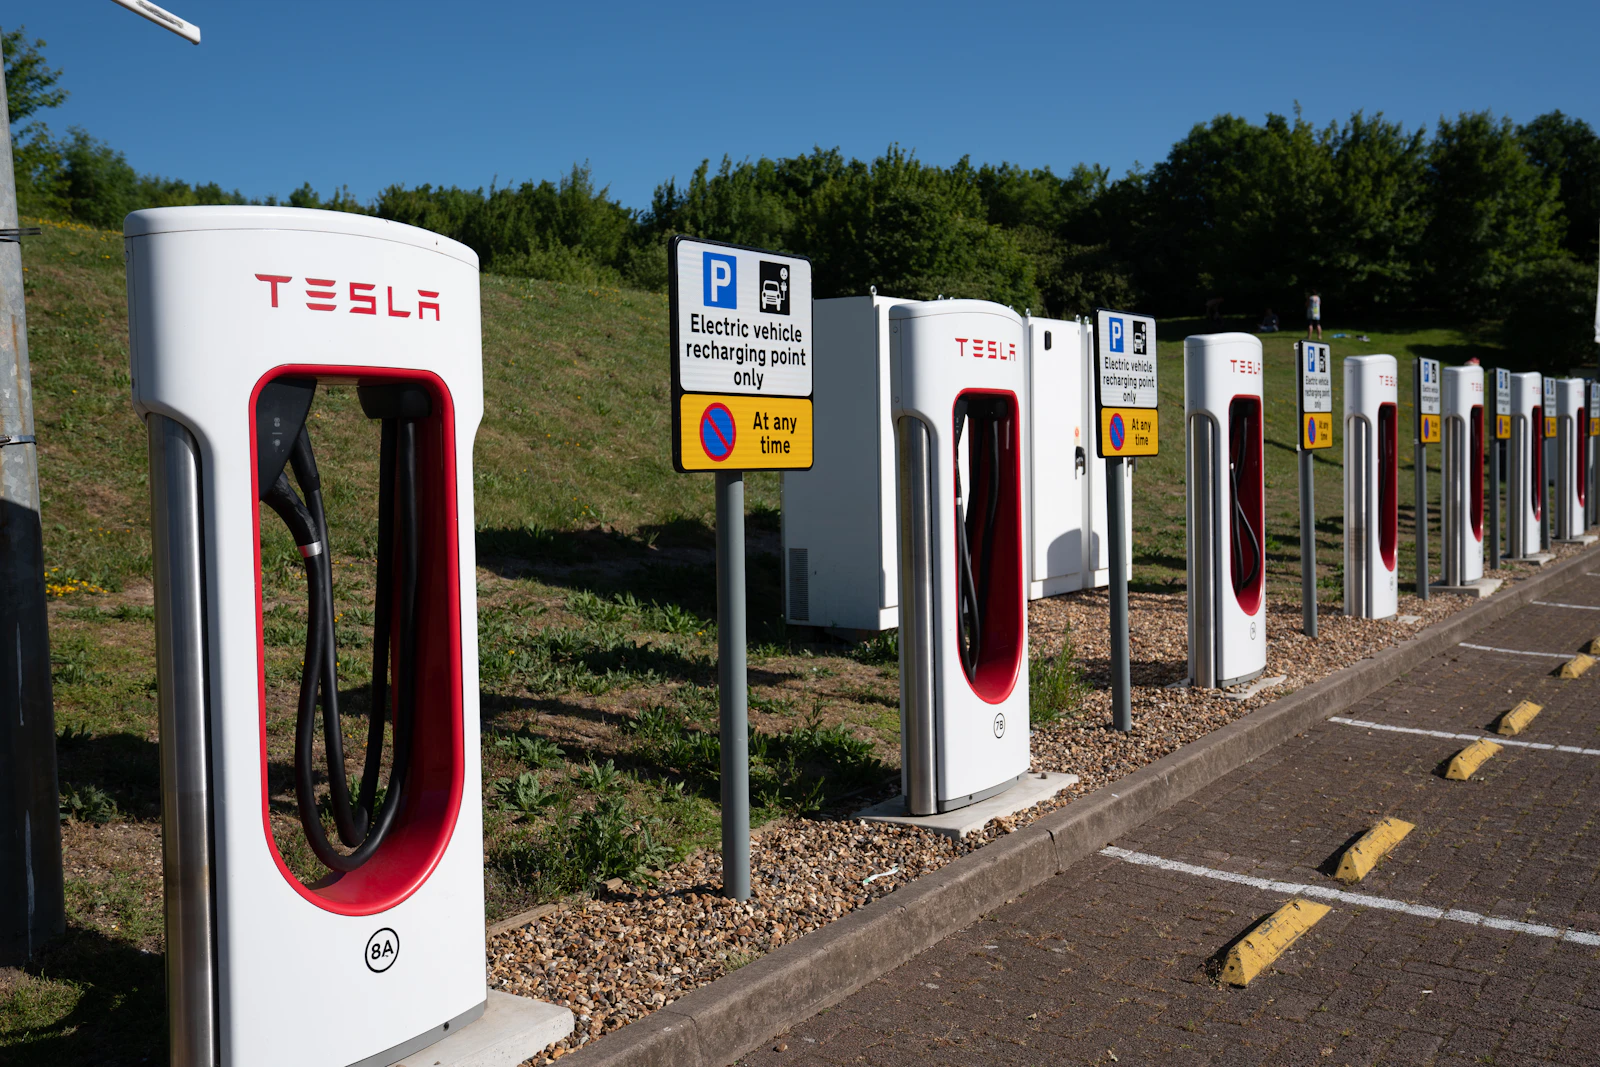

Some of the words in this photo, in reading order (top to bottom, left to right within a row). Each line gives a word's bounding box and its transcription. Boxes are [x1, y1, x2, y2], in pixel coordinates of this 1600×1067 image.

[710, 258, 731, 302] P
[254, 273, 440, 321] TESLA
[691, 313, 749, 338] Electric
[753, 321, 802, 343] vehicle
[1112, 321, 1121, 349] P
[686, 340, 766, 367] recharging
[771, 348, 806, 367] point
[955, 337, 1016, 361] TESLA
[1104, 356, 1129, 371] Electric
[1131, 360, 1152, 373] vehicle
[733, 368, 764, 390] only
[1103, 373, 1137, 389] recharging
[1139, 376, 1154, 389] point
[1123, 390, 1136, 404] only
[753, 411, 769, 430] At
[773, 416, 797, 434] any
[1132, 418, 1139, 430] At
[1140, 422, 1151, 432] any
[760, 436, 790, 454] time
[1135, 434, 1148, 446] time
[995, 720, 1004, 731] 7B
[371, 939, 394, 960] 8A
